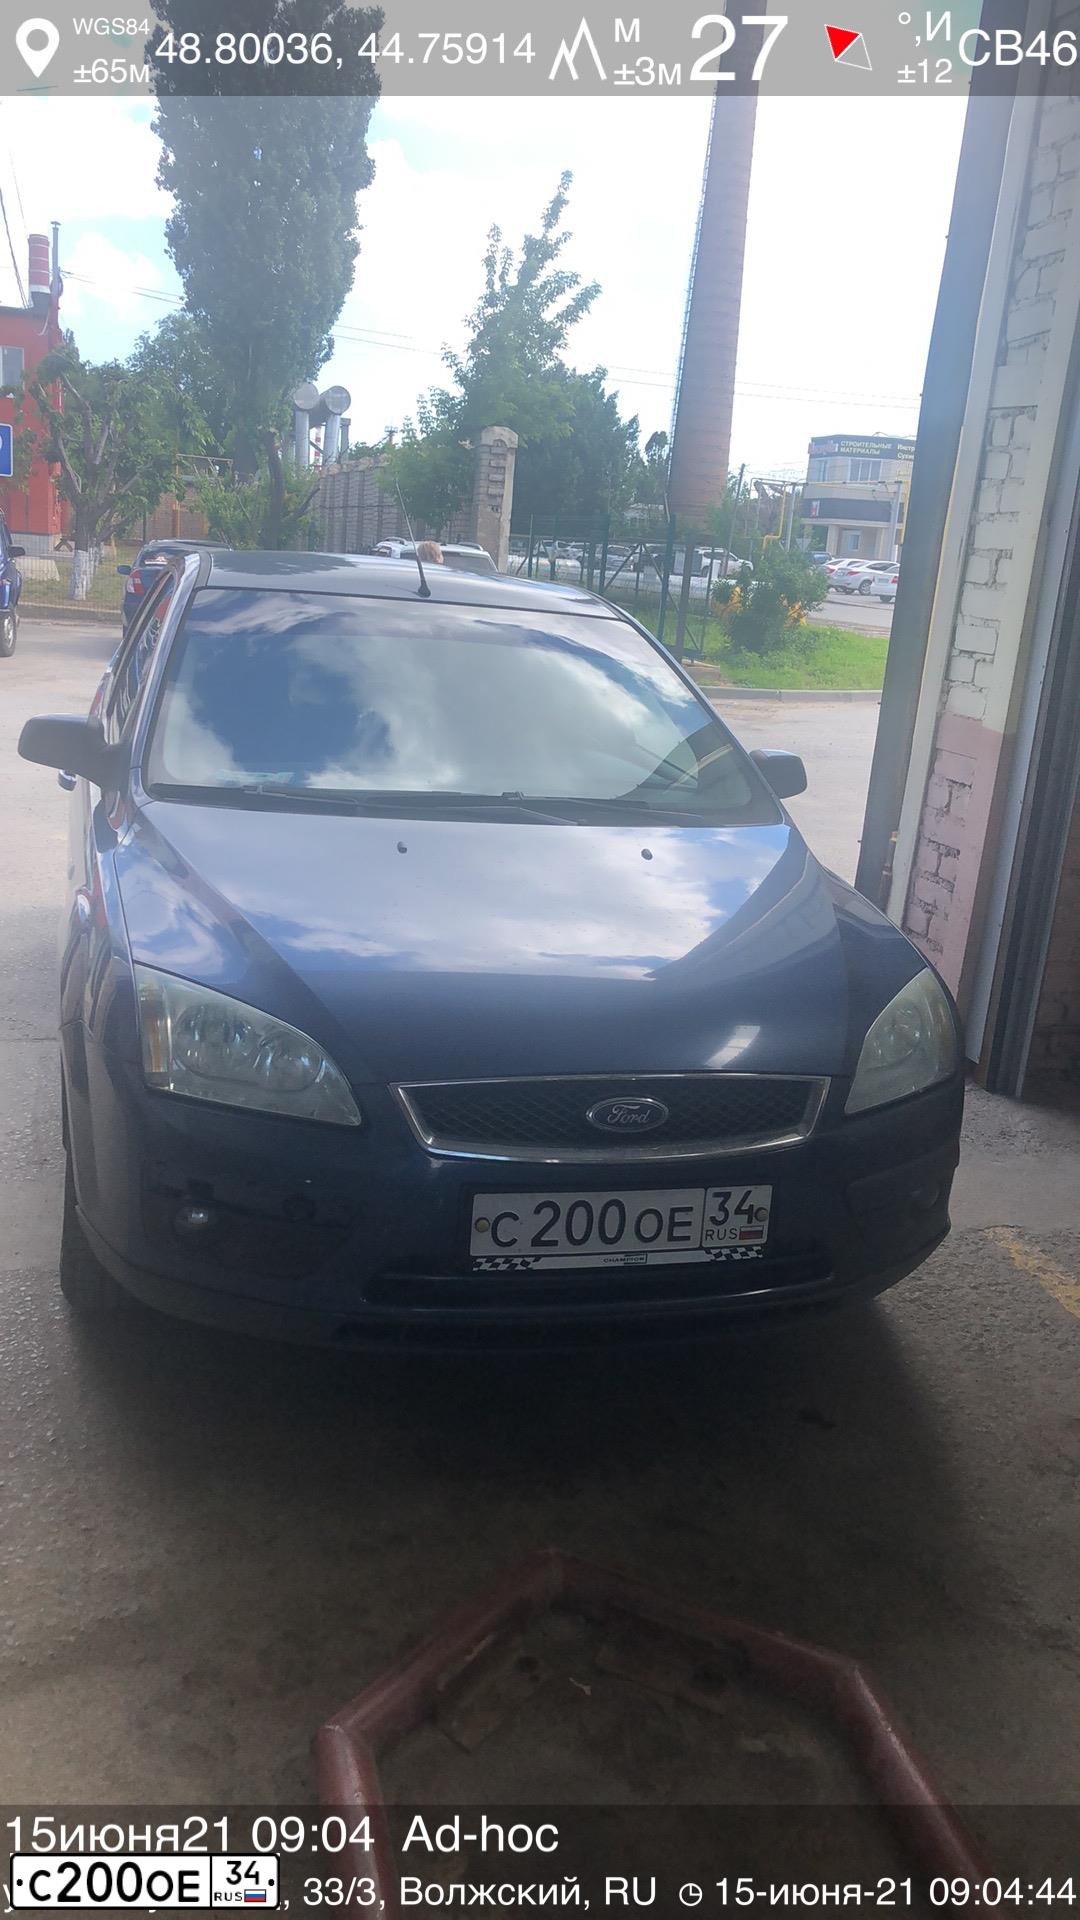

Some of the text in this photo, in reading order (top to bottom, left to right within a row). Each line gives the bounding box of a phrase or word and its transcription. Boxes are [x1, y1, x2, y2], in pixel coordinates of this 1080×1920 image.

[840, 440, 893, 450] СТРОИТЕЛЬНЫЕ
[840, 446, 881, 455] МАТЕРИАЛЫ
[607, 1104, 651, 1124] Ford
[709, 1190, 754, 1227] 34
[704, 1228, 738, 1241] RUS
